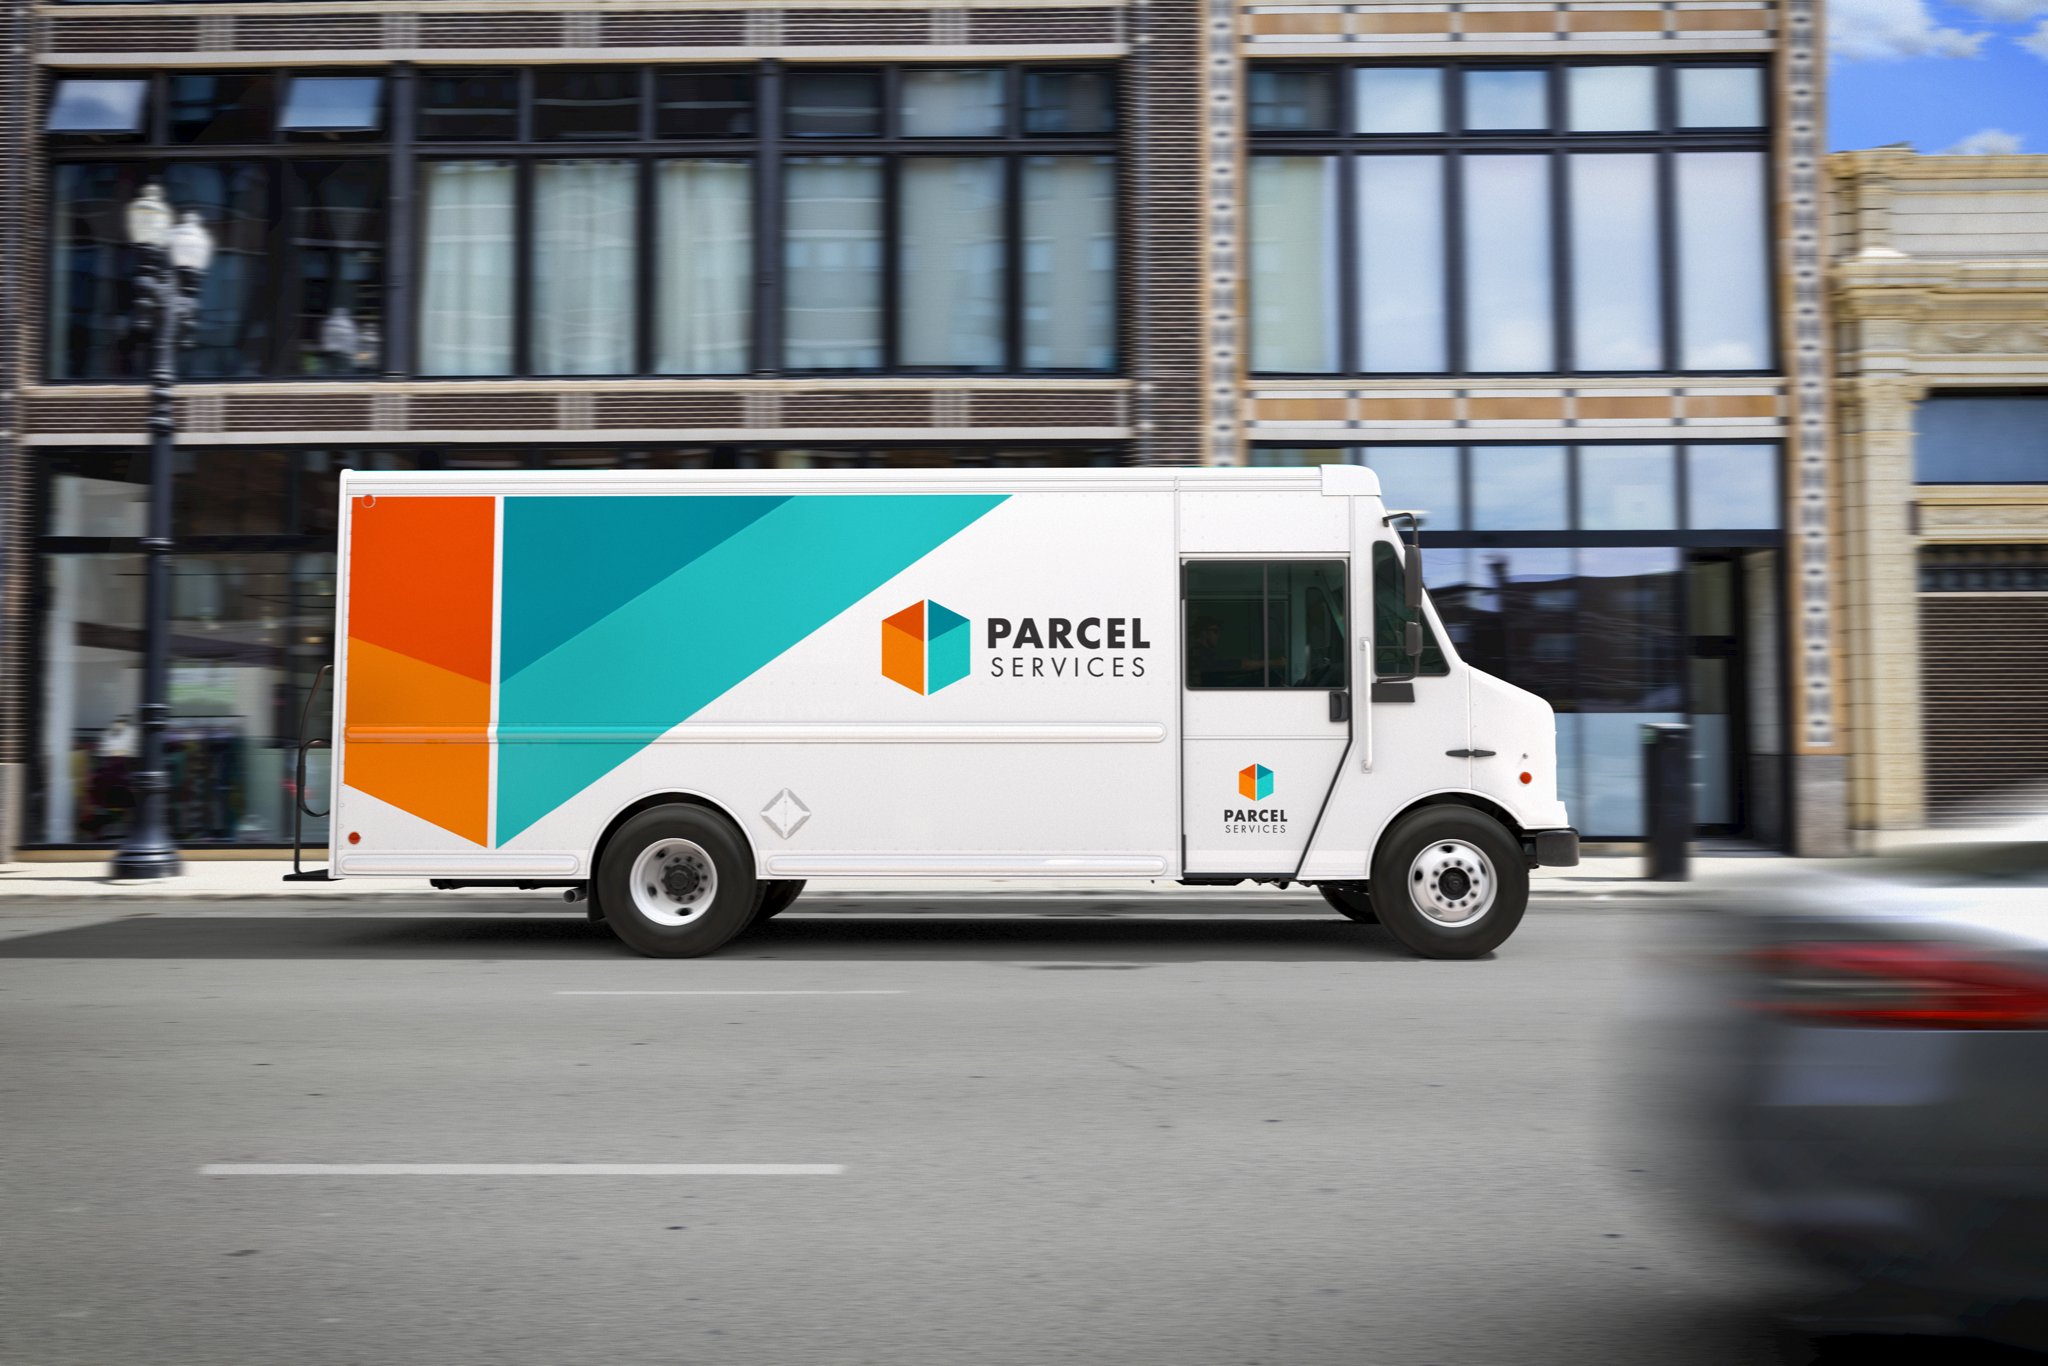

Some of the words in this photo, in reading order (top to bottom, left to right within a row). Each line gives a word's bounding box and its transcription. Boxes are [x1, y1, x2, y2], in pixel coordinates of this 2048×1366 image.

[987, 616, 1151, 650] PARCEL
[990, 656, 1146, 678] SERVICES
[1223, 809, 1288, 823] PARCEL
[1225, 824, 1287, 834] SERVICES
